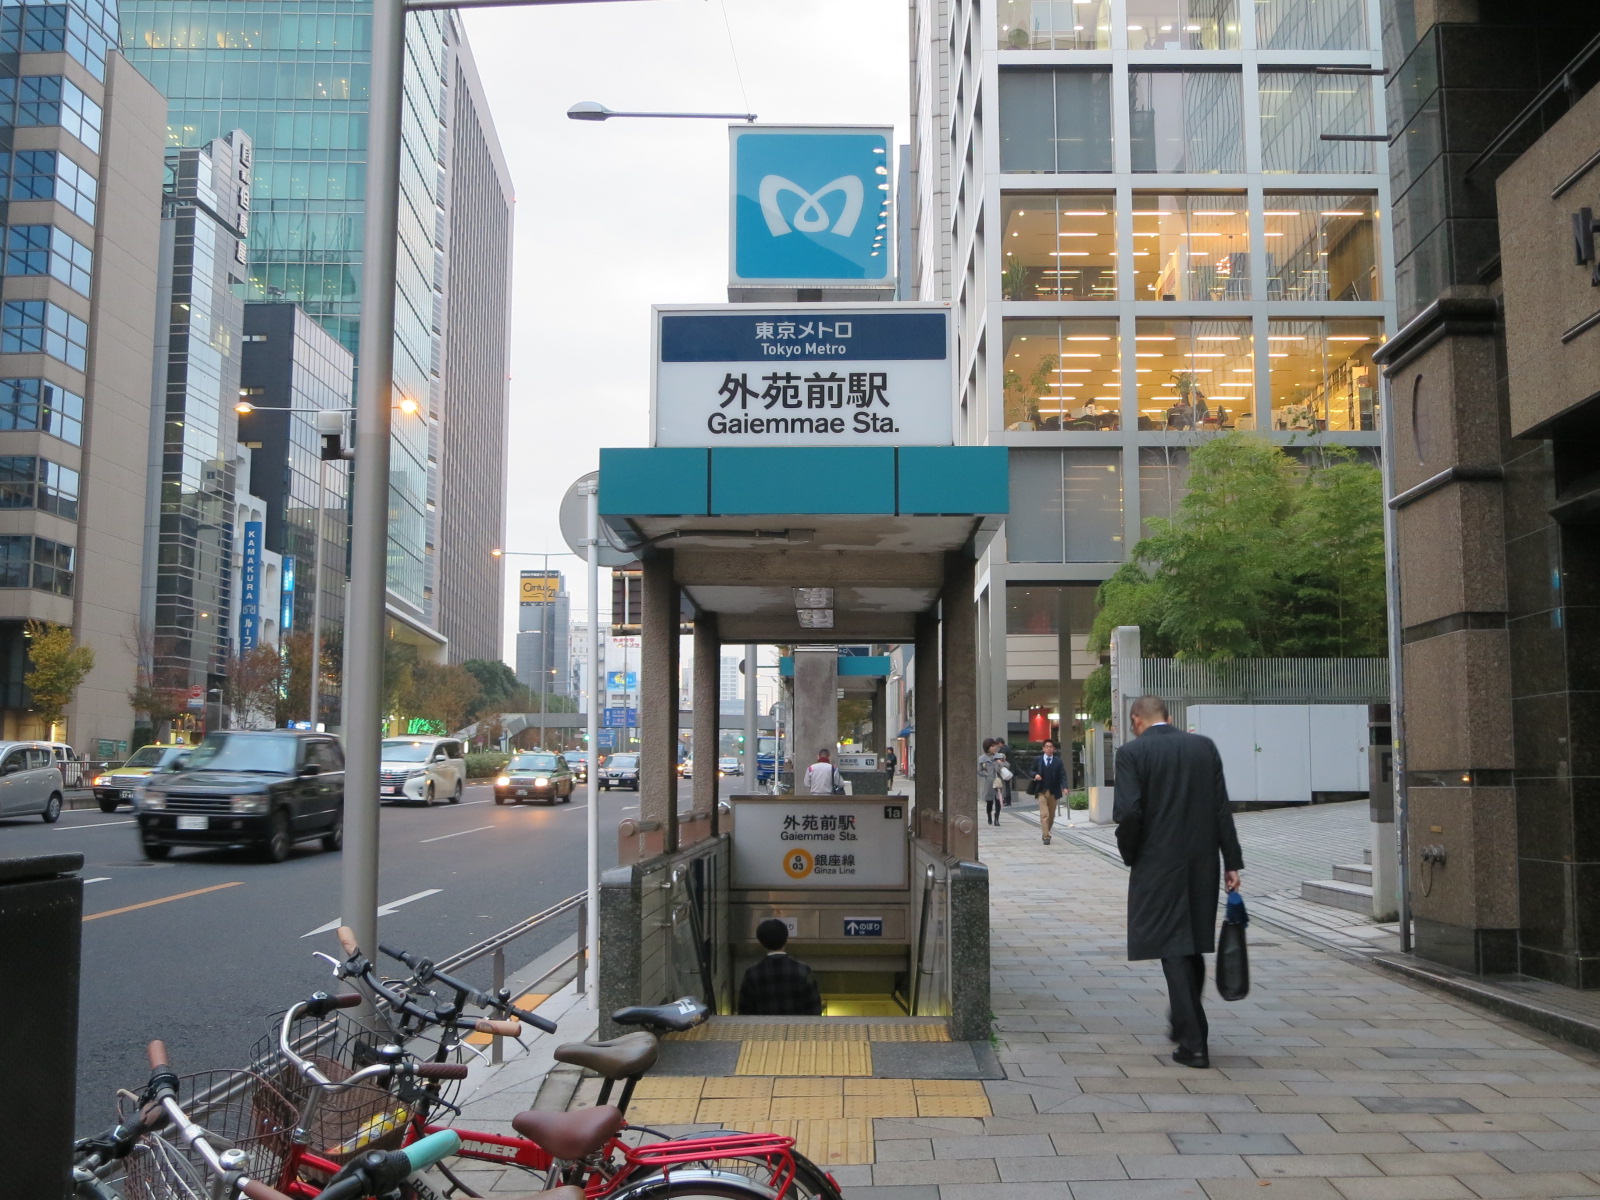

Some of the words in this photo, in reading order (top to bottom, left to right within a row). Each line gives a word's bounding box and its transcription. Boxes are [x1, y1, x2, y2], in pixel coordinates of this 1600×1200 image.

[755, 321, 852, 340] 東京メトロ
[761, 343, 801, 358] Tokyo
[805, 343, 846, 355] Metro
[717, 371, 890, 410] 外苑前駅
[707, 412, 845, 434] Gaiemmae
[852, 411, 900, 434] Sta.
[246, 530, 256, 600] KAMAKURA
[887, 807, 900, 819] 1a
[783, 815, 856, 831] 外苑前駅
[780, 831, 835, 841] Gaiemmae
[839, 831, 858, 841] Sta.
[792, 863, 804, 871] 03
[814, 854, 855, 867] 銀座線
[814, 867, 836, 875] Ginza
[839, 866, 855, 875] Line
[859, 923, 880, 931] のぼり
